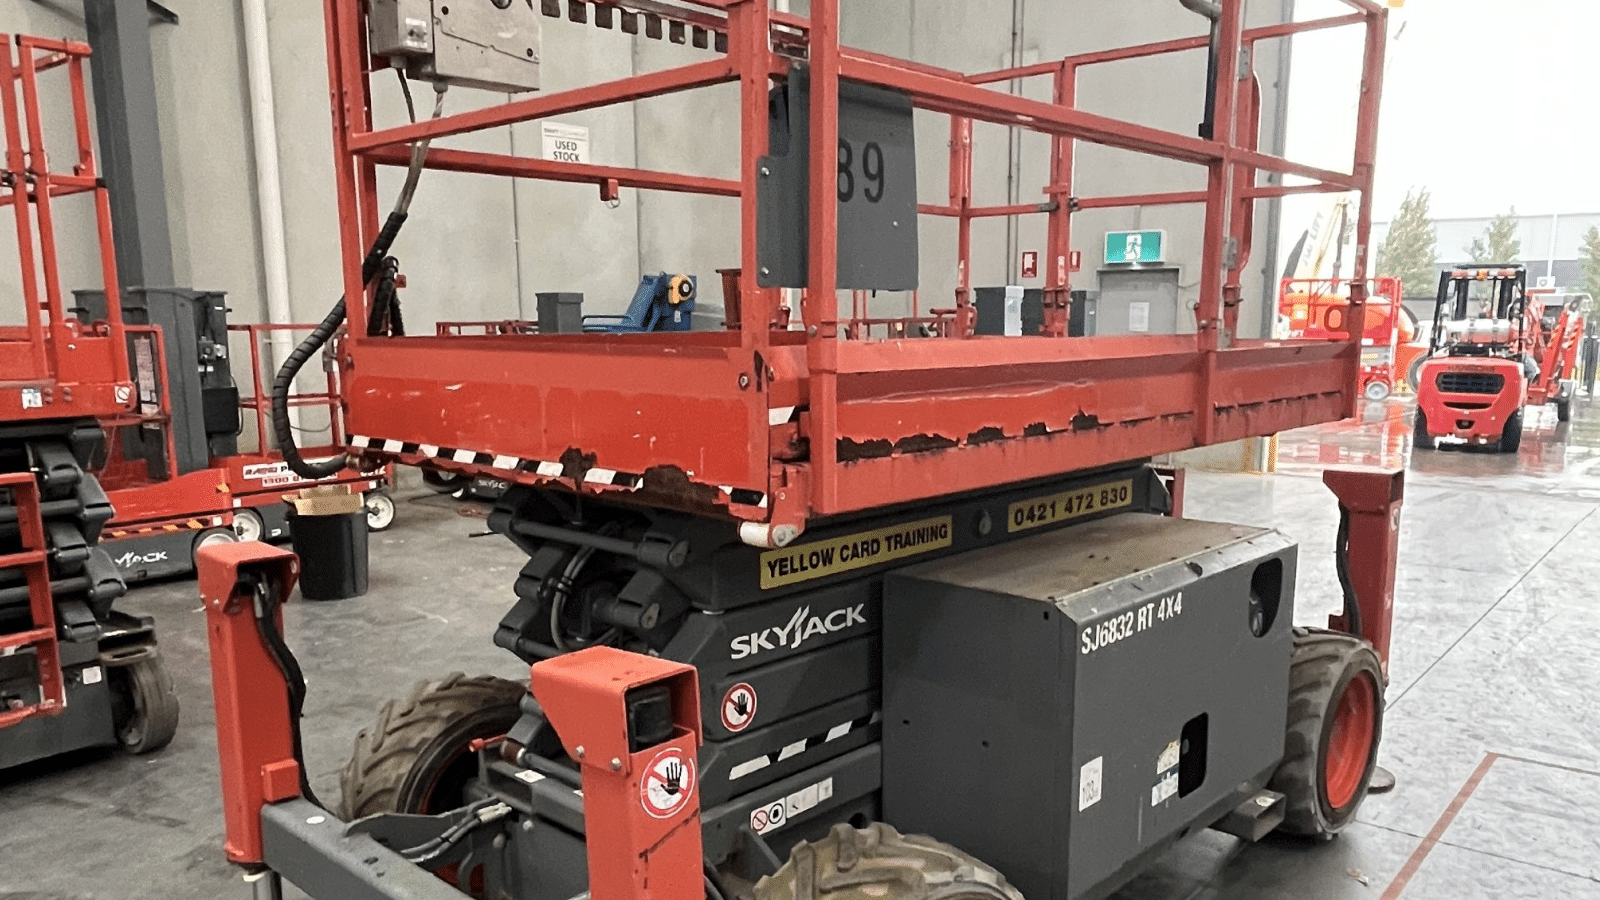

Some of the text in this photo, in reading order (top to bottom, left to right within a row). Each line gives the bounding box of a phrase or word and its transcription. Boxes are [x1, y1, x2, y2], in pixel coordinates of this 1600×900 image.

[553, 150, 580, 163] STOCK
[554, 140, 578, 152] USED
[1013, 485, 1128, 526] 0421 472 830
[767, 523, 948, 578] YELLOW CARD TRAINING
[730, 603, 866, 660] SKYJACK
[1081, 591, 1182, 655] SJ6832 RT 4X4
